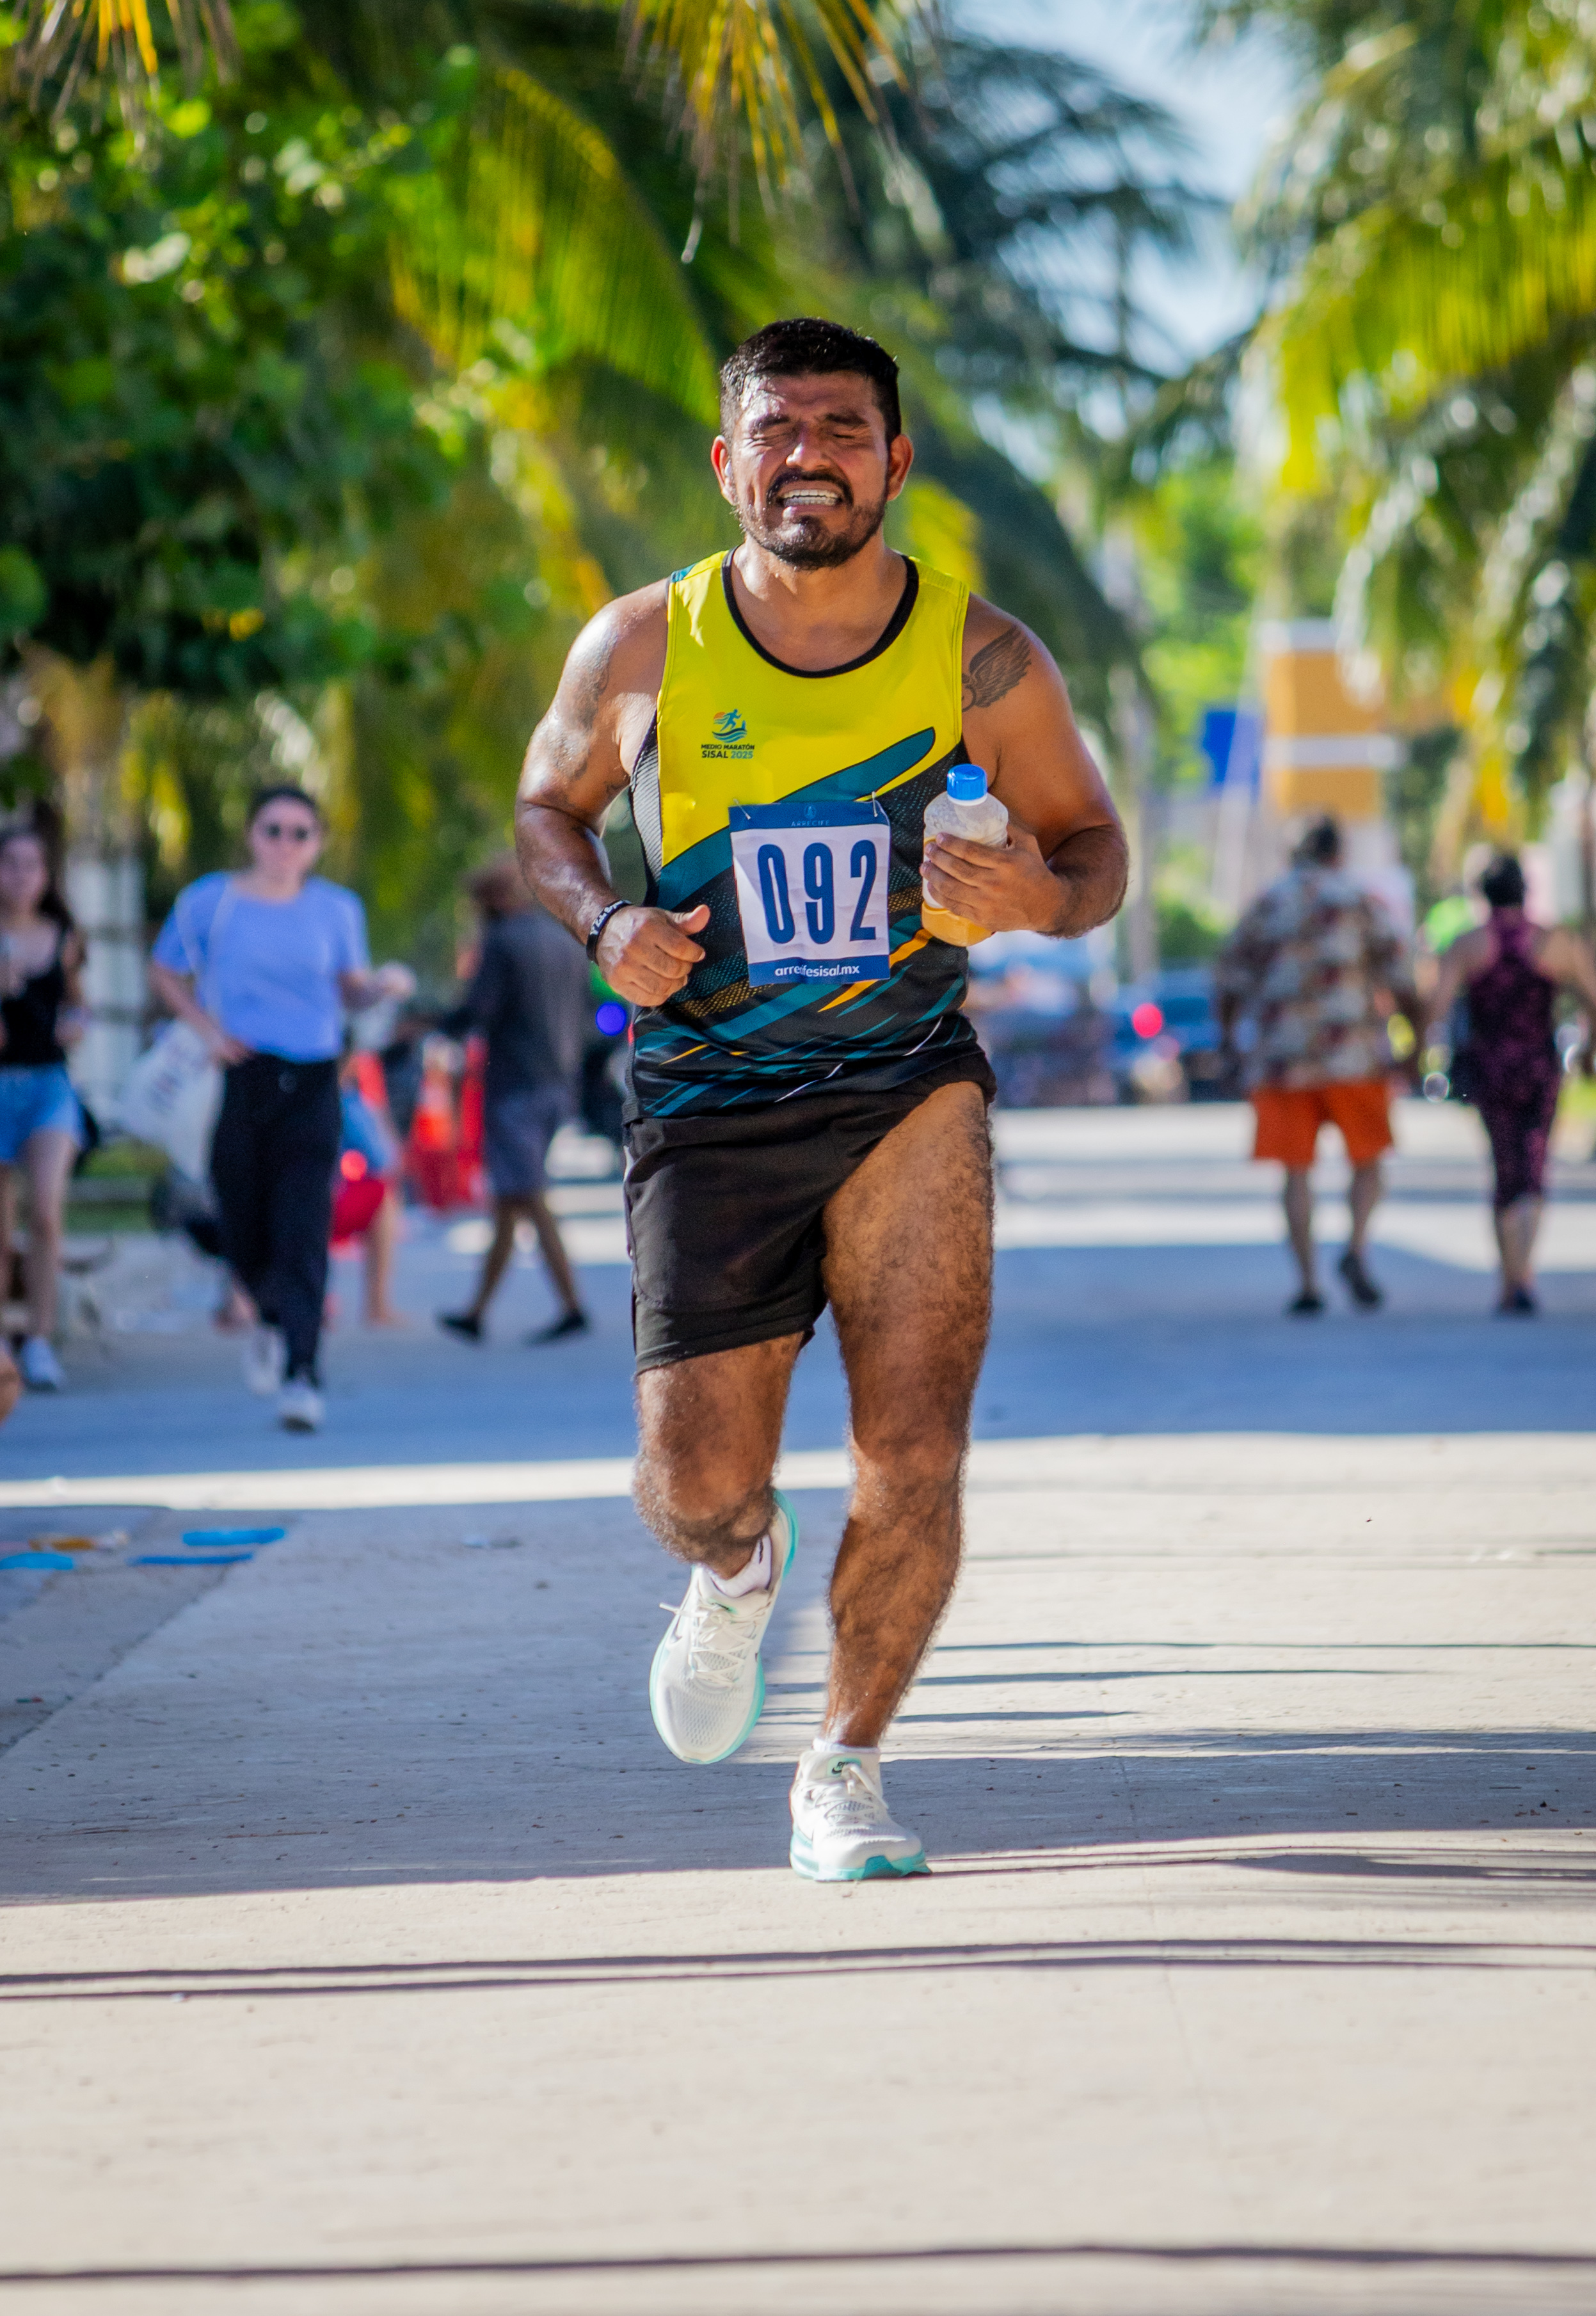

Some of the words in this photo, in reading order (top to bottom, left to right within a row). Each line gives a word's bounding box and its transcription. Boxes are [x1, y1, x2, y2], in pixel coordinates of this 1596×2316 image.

[702, 750, 728, 758] SISAL
[731, 751, 753, 759] 2025
[757, 840, 877, 945] 092
